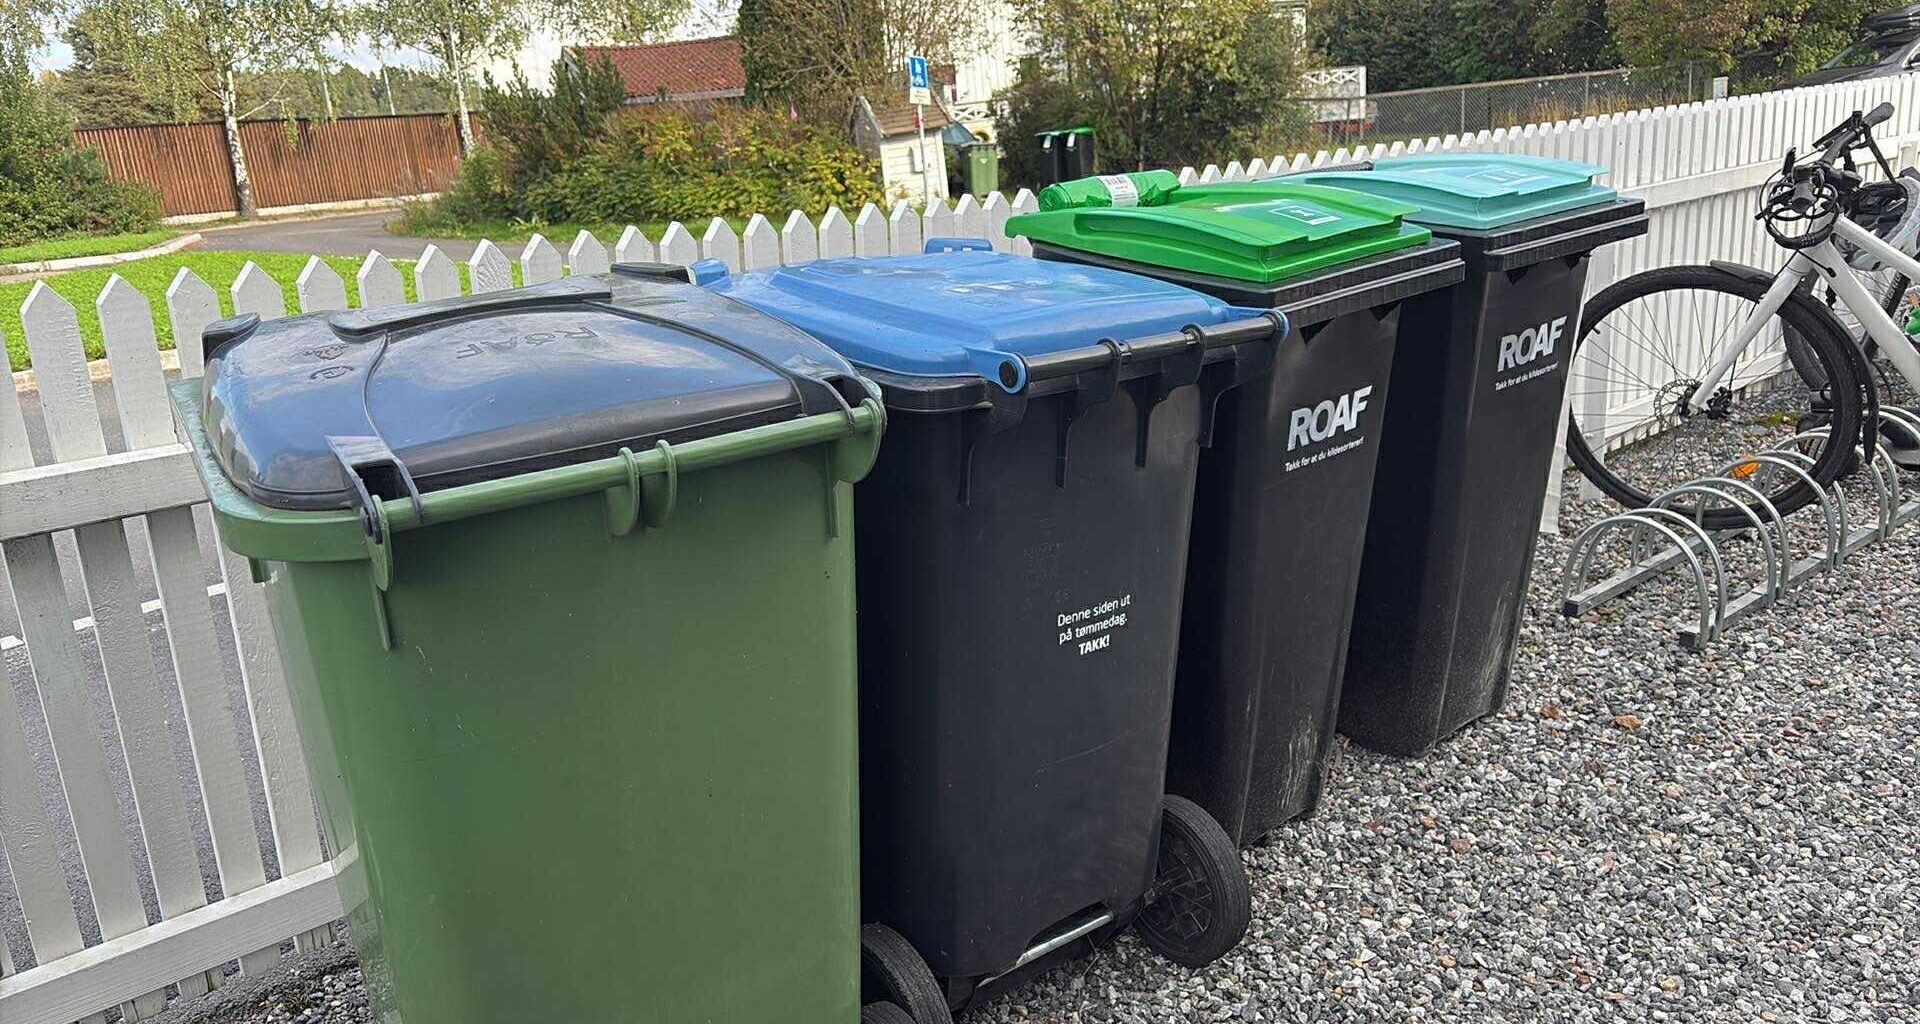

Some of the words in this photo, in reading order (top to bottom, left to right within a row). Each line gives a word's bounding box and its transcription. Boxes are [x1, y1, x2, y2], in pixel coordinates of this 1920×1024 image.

[1497, 315, 1568, 372] ROAF
[1287, 385, 1373, 451] ROAF
[1285, 460, 1301, 472] Takk
[1057, 609, 1091, 627] Denne
[1093, 600, 1119, 616] siden
[1120, 594, 1131, 607] ut
[1059, 627, 1073, 645] på
[1075, 612, 1128, 638] tømmedag.
[1078, 634, 1110, 655] TAKK!
